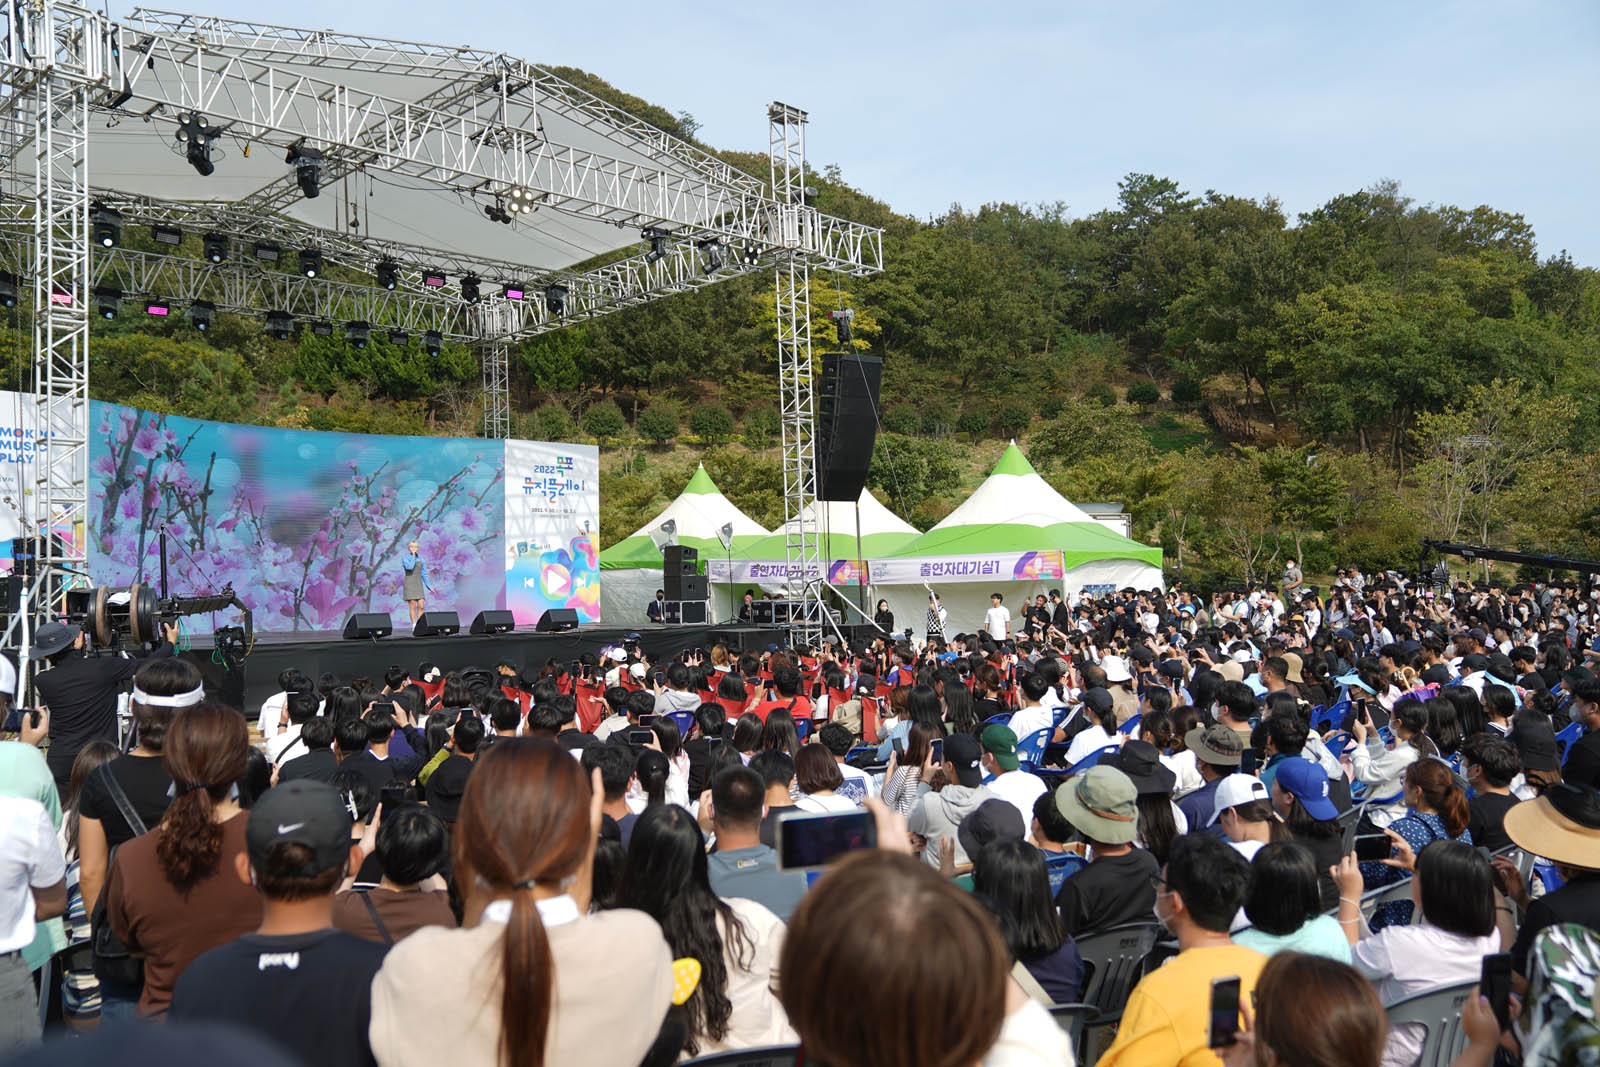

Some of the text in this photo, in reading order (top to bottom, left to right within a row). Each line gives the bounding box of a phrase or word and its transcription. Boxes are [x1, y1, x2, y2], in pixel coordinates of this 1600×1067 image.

[0, 452, 34, 464] PLAY
[533, 456, 574, 478] 2022 목포
[522, 477, 585, 504] 뮤직플레이
[920, 560, 1001, 577] 출연자대기실1
